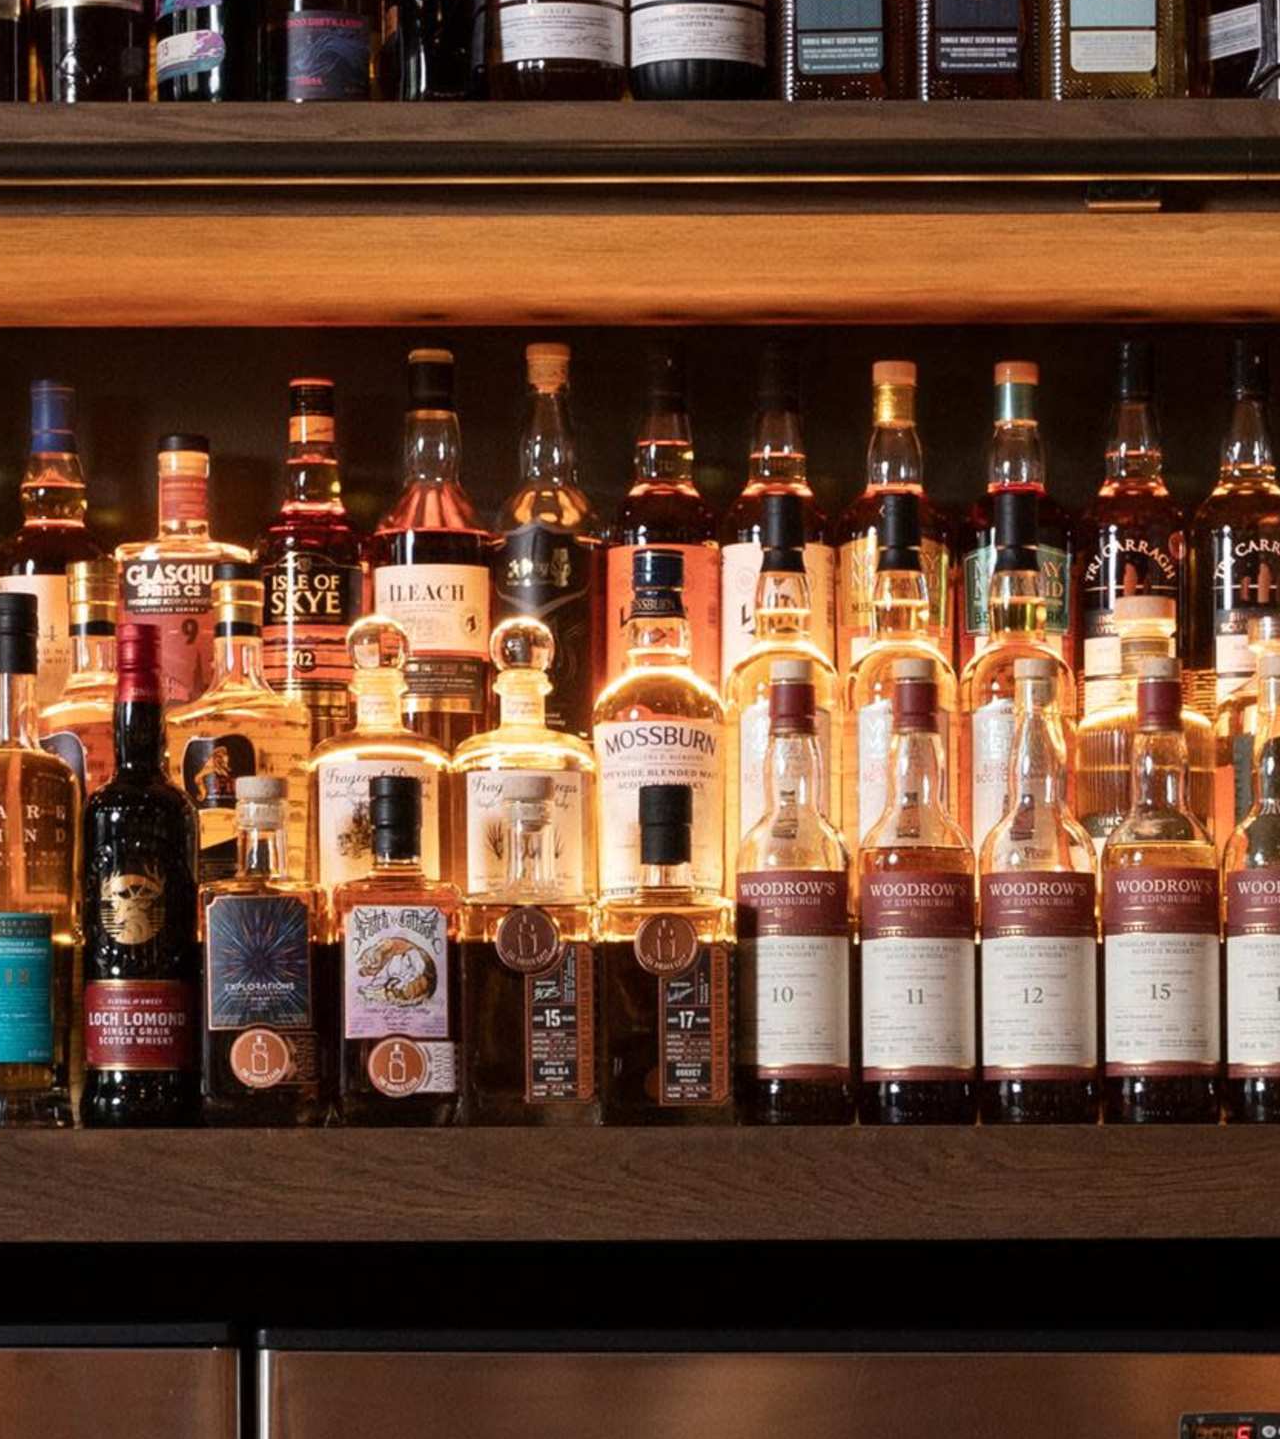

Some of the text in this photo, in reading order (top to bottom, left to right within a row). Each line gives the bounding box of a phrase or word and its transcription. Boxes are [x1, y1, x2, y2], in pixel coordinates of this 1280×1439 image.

[125, 564, 214, 586] GLASCHU
[313, 574, 341, 591] OF
[271, 592, 342, 615] SKYE
[181, 618, 199, 646] 9
[298, 651, 314, 667] 12
[604, 726, 717, 757] MOSSBURN
[740, 882, 837, 897] WOODROW'S
[870, 883, 968, 898] WOODROW'S
[989, 882, 1087, 897] WOODROW'S
[1116, 879, 1214, 894] WOODROW'S
[224, 981, 295, 992] EXPLORATIONS
[1149, 983, 1171, 1000] 15
[771, 987, 794, 1004] 10
[907, 988, 925, 1005] 11
[1022, 987, 1044, 1004] 12
[88, 1012, 186, 1026] LOCH LOMOND
[544, 1009, 561, 1027] 15
[678, 1010, 695, 1029] 17
